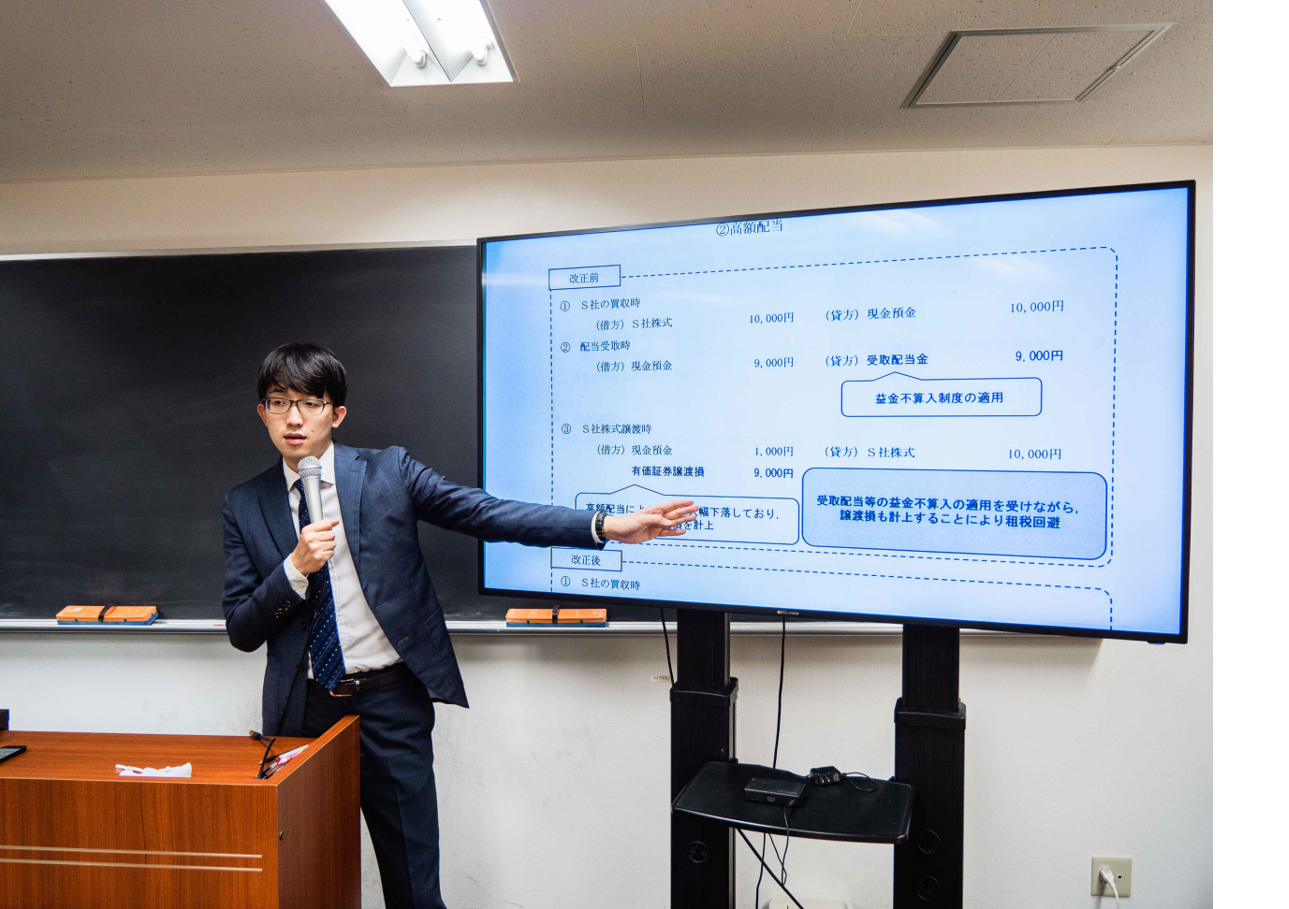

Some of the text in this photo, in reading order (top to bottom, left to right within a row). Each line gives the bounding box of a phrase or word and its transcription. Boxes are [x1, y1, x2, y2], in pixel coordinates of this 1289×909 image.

[570, 272, 599, 284] 改正前
[582, 297, 640, 310] S社の買収時
[1010, 300, 1064, 314] 10,000円
[749, 312, 794, 324] 10,000円
[580, 340, 631, 352] 配当受取時
[1015, 350, 1064, 362] 9,000円
[753, 357, 794, 369] 9,000円
[876, 392, 1003, 404] 益金不算入制度の適用
[582, 424, 652, 435] S社株式譲渡時
[755, 446, 794, 457] 1,000円
[1008, 449, 1062, 461] 10,000円
[632, 466, 794, 479] 有価証券譲渡損 9,000円
[839, 509, 1061, 530] 譲渡損も計上することにより租税回避
[571, 554, 601, 567] 改正後
[581, 577, 641, 591] S社の買収時
